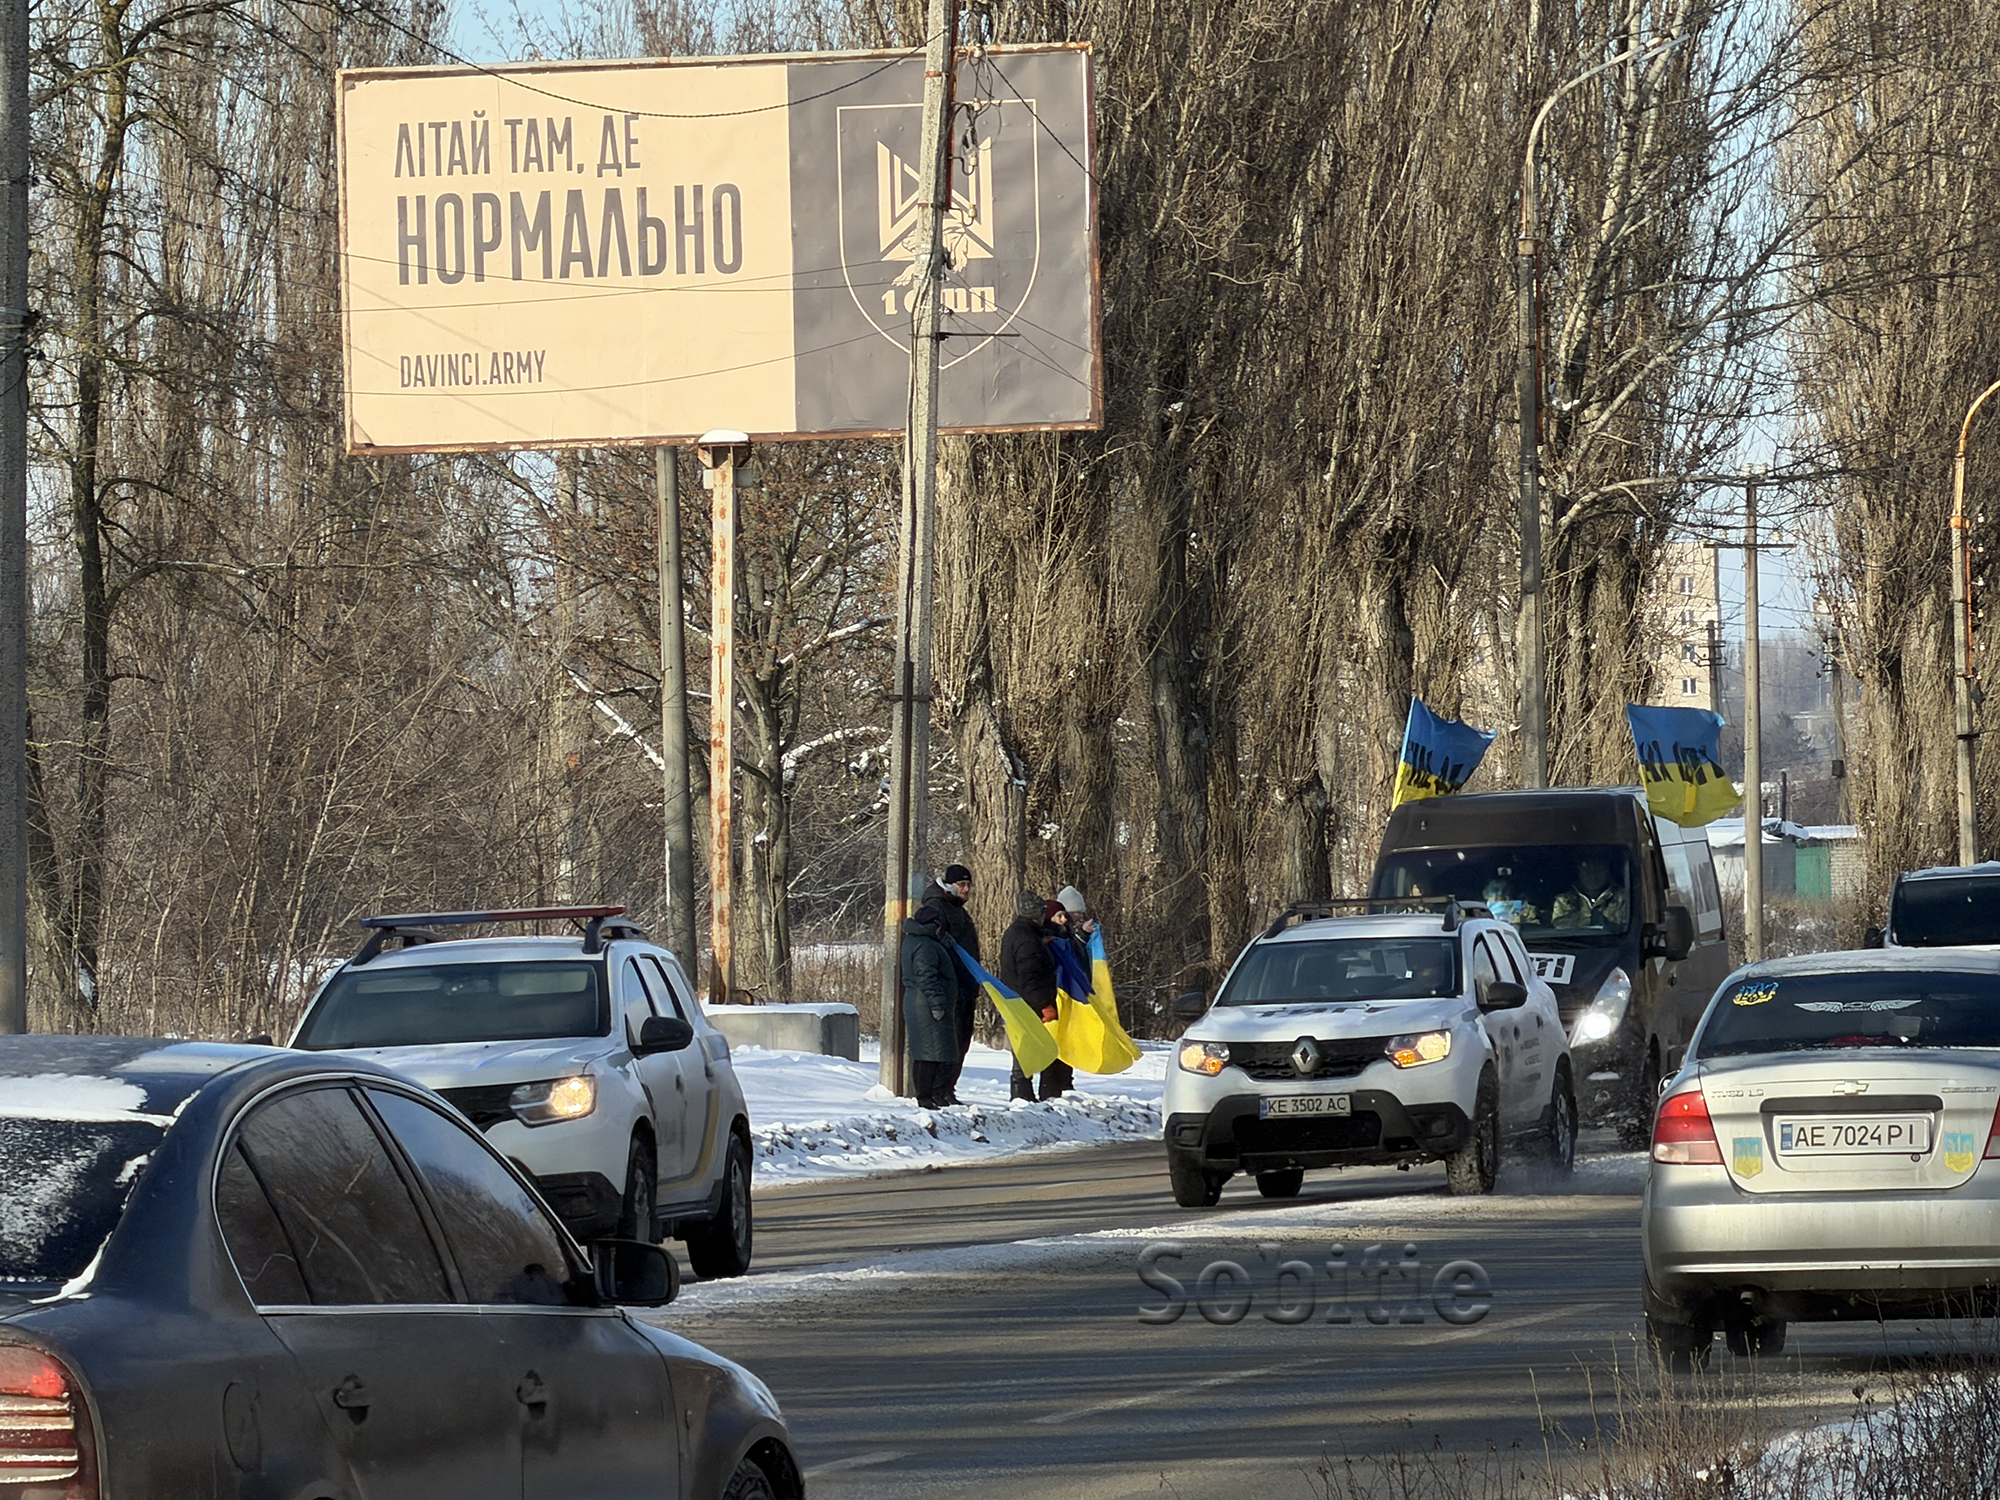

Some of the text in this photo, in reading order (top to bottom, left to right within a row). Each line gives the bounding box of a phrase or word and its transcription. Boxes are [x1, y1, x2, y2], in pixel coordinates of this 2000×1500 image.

[395, 110, 641, 178] ЛІТАЙ ТАМ, ДЕ
[398, 183, 743, 286] НОРМАЛЬНО
[400, 350, 546, 389] DAVINCI.ARMY
[1268, 1097, 1347, 1113] KE 3502 AC
[1795, 1124, 1914, 1148] AE 7024 PI
